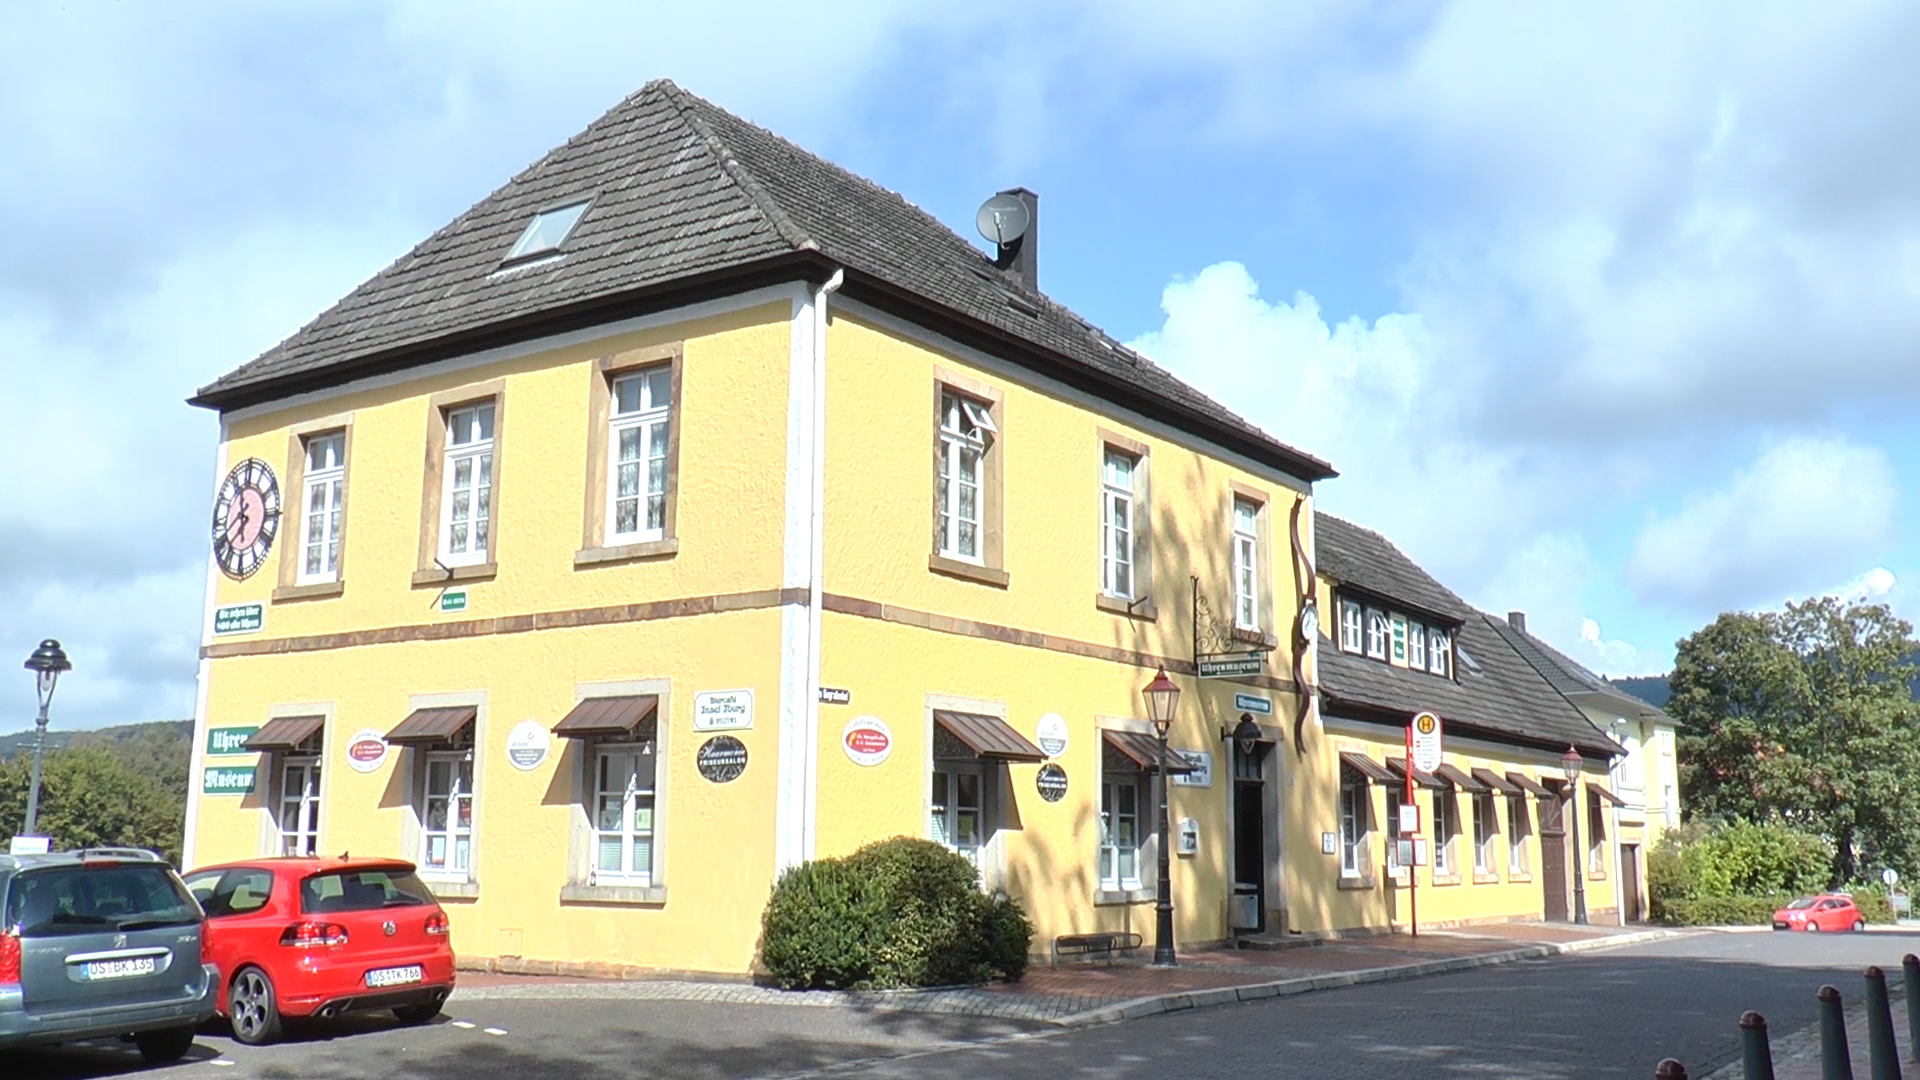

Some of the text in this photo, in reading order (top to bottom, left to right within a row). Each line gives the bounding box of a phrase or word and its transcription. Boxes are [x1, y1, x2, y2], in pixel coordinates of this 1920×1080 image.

[1201, 662, 1260, 673] Uhrenmuseum
[701, 705, 721, 714] Insel
[1422, 719, 1431, 730] H
[700, 757, 746, 766] FRISEURSALON
[205, 770, 254, 788] Museum
[90, 958, 153, 975] OS BK 135
[373, 968, 420, 982] OS TK 766
